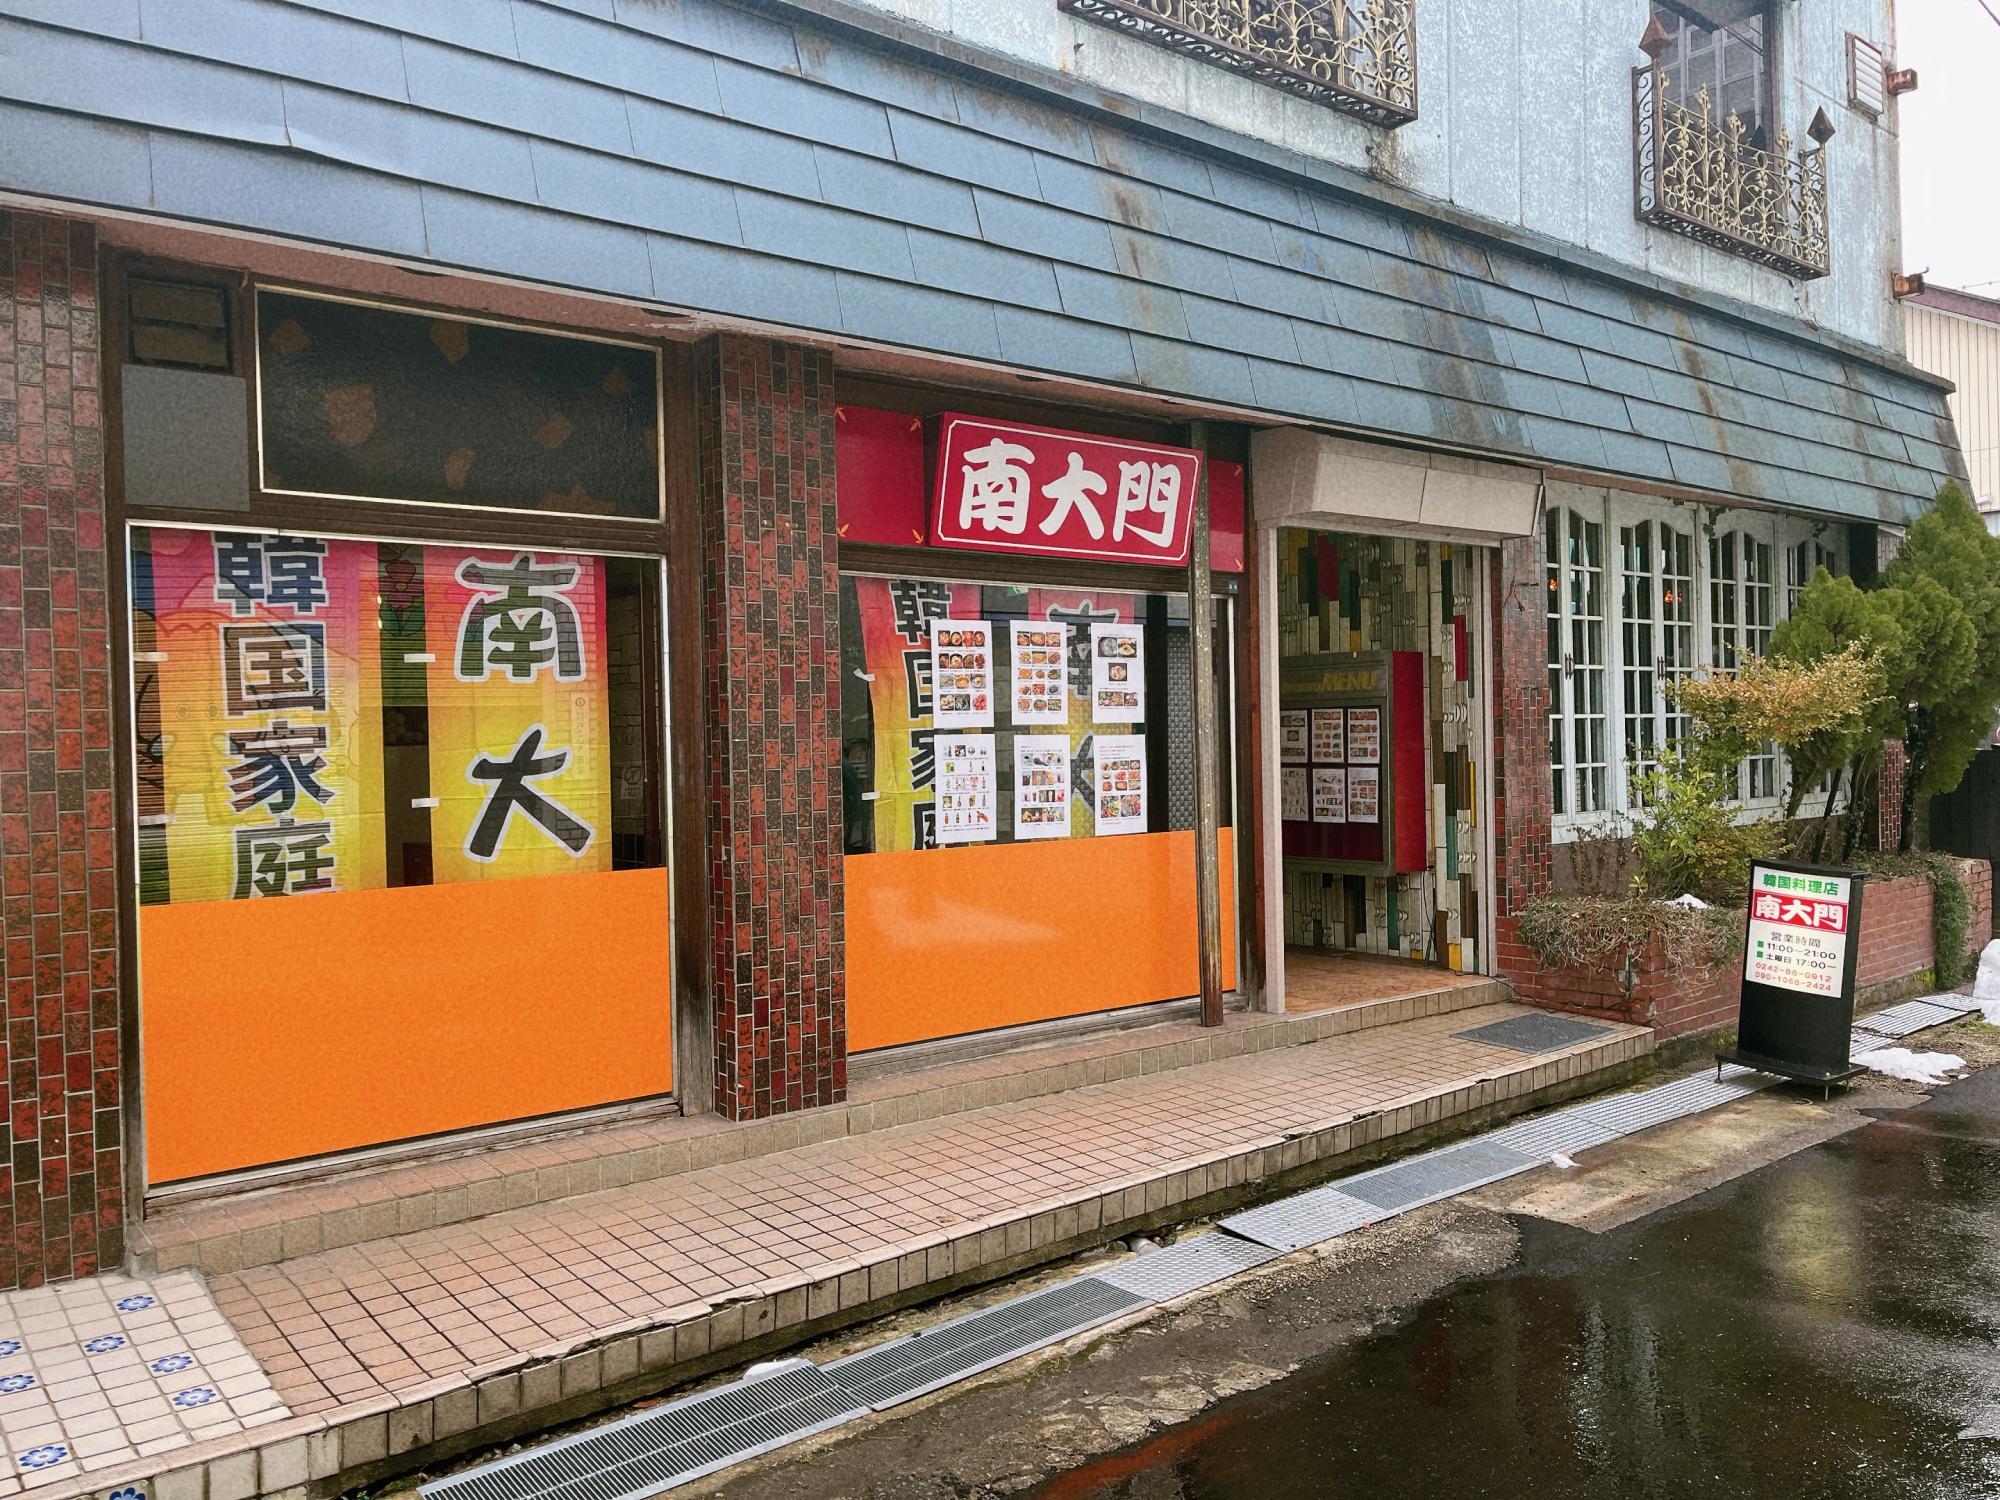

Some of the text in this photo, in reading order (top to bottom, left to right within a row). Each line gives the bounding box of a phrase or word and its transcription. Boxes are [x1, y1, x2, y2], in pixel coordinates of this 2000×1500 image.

[958, 437, 1181, 548] 南大門
[1322, 670, 1377, 691] MENU
[212, 534, 338, 901] 韓国家庭
[454, 552, 596, 863] 南大
[1762, 873, 1839, 896] 韓国料理店
[1756, 895, 1844, 930] 南大門
[1771, 931, 1821, 948] 営業時間
[1766, 953, 1792, 964] 土曜日
